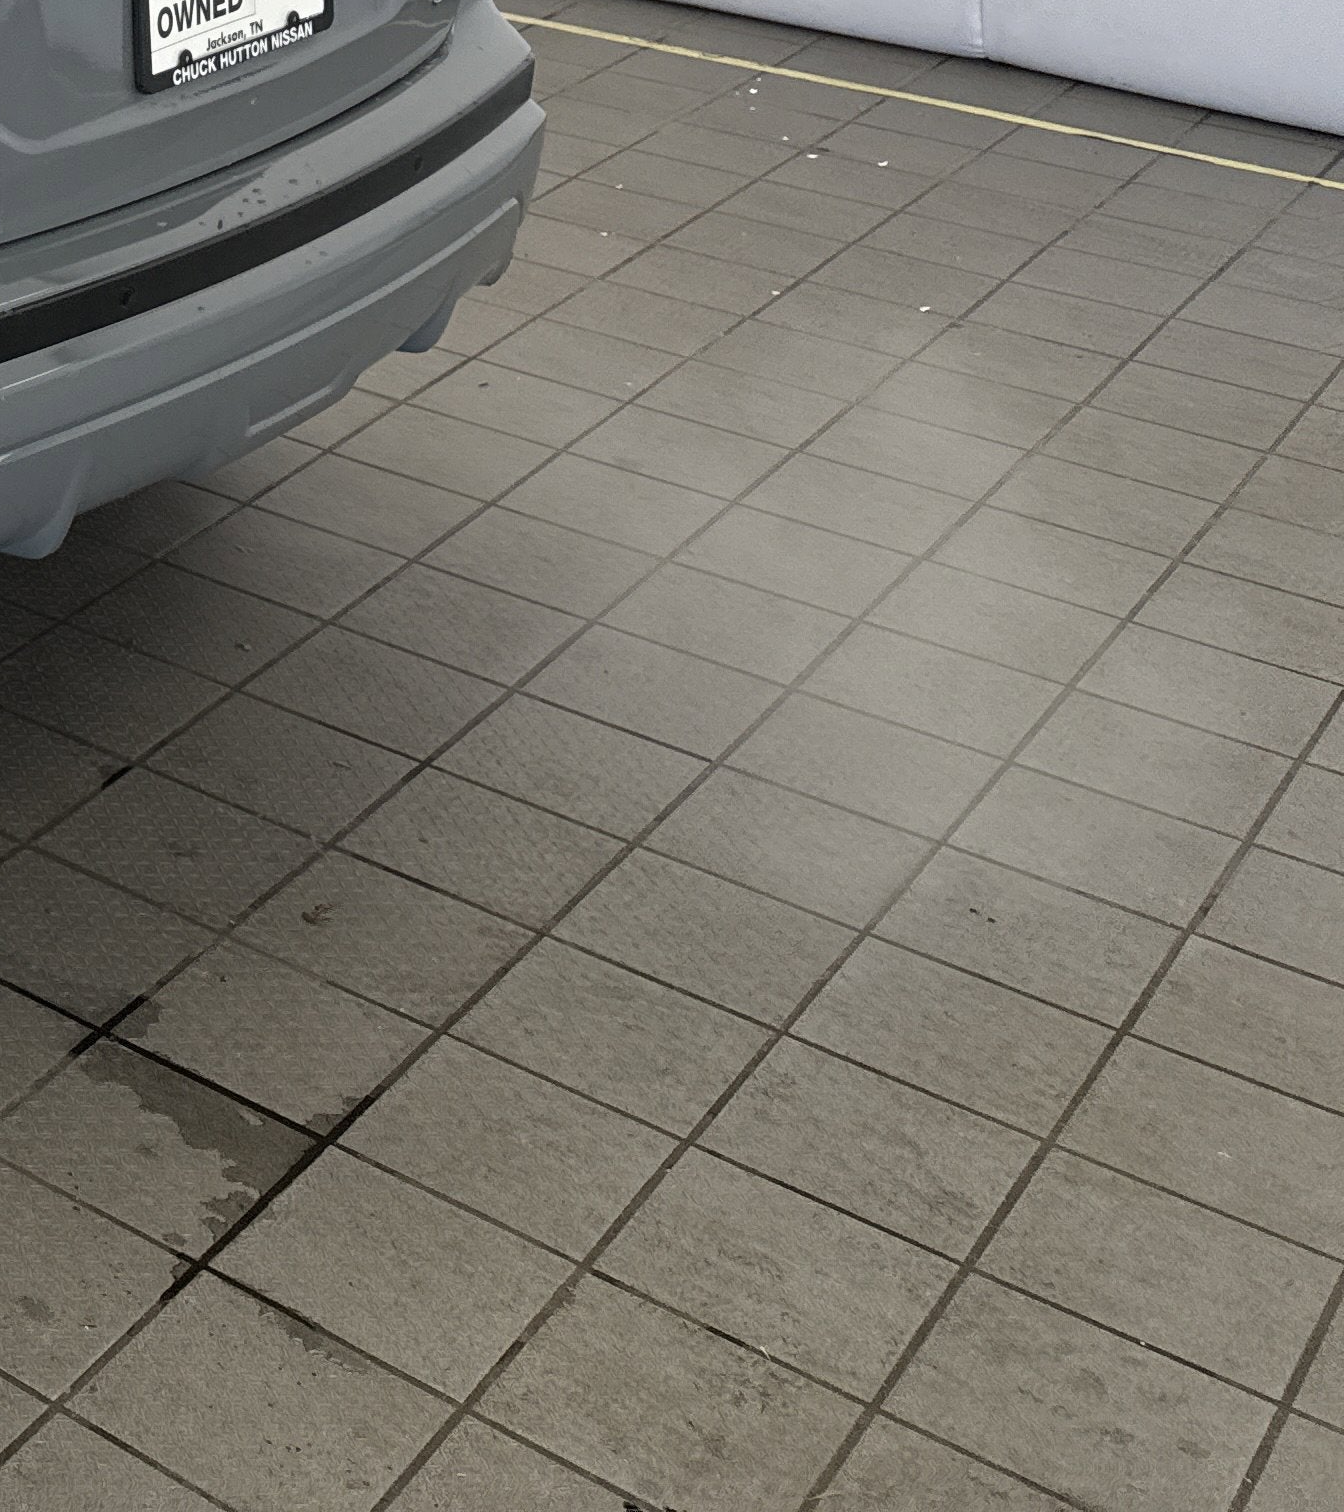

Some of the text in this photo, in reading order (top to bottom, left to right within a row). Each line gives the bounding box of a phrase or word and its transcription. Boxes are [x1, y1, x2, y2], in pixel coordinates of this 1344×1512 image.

[172, 20, 314, 86] CHUCK HUTTON NISSAN
[206, 19, 263, 51] Jackson, TN
